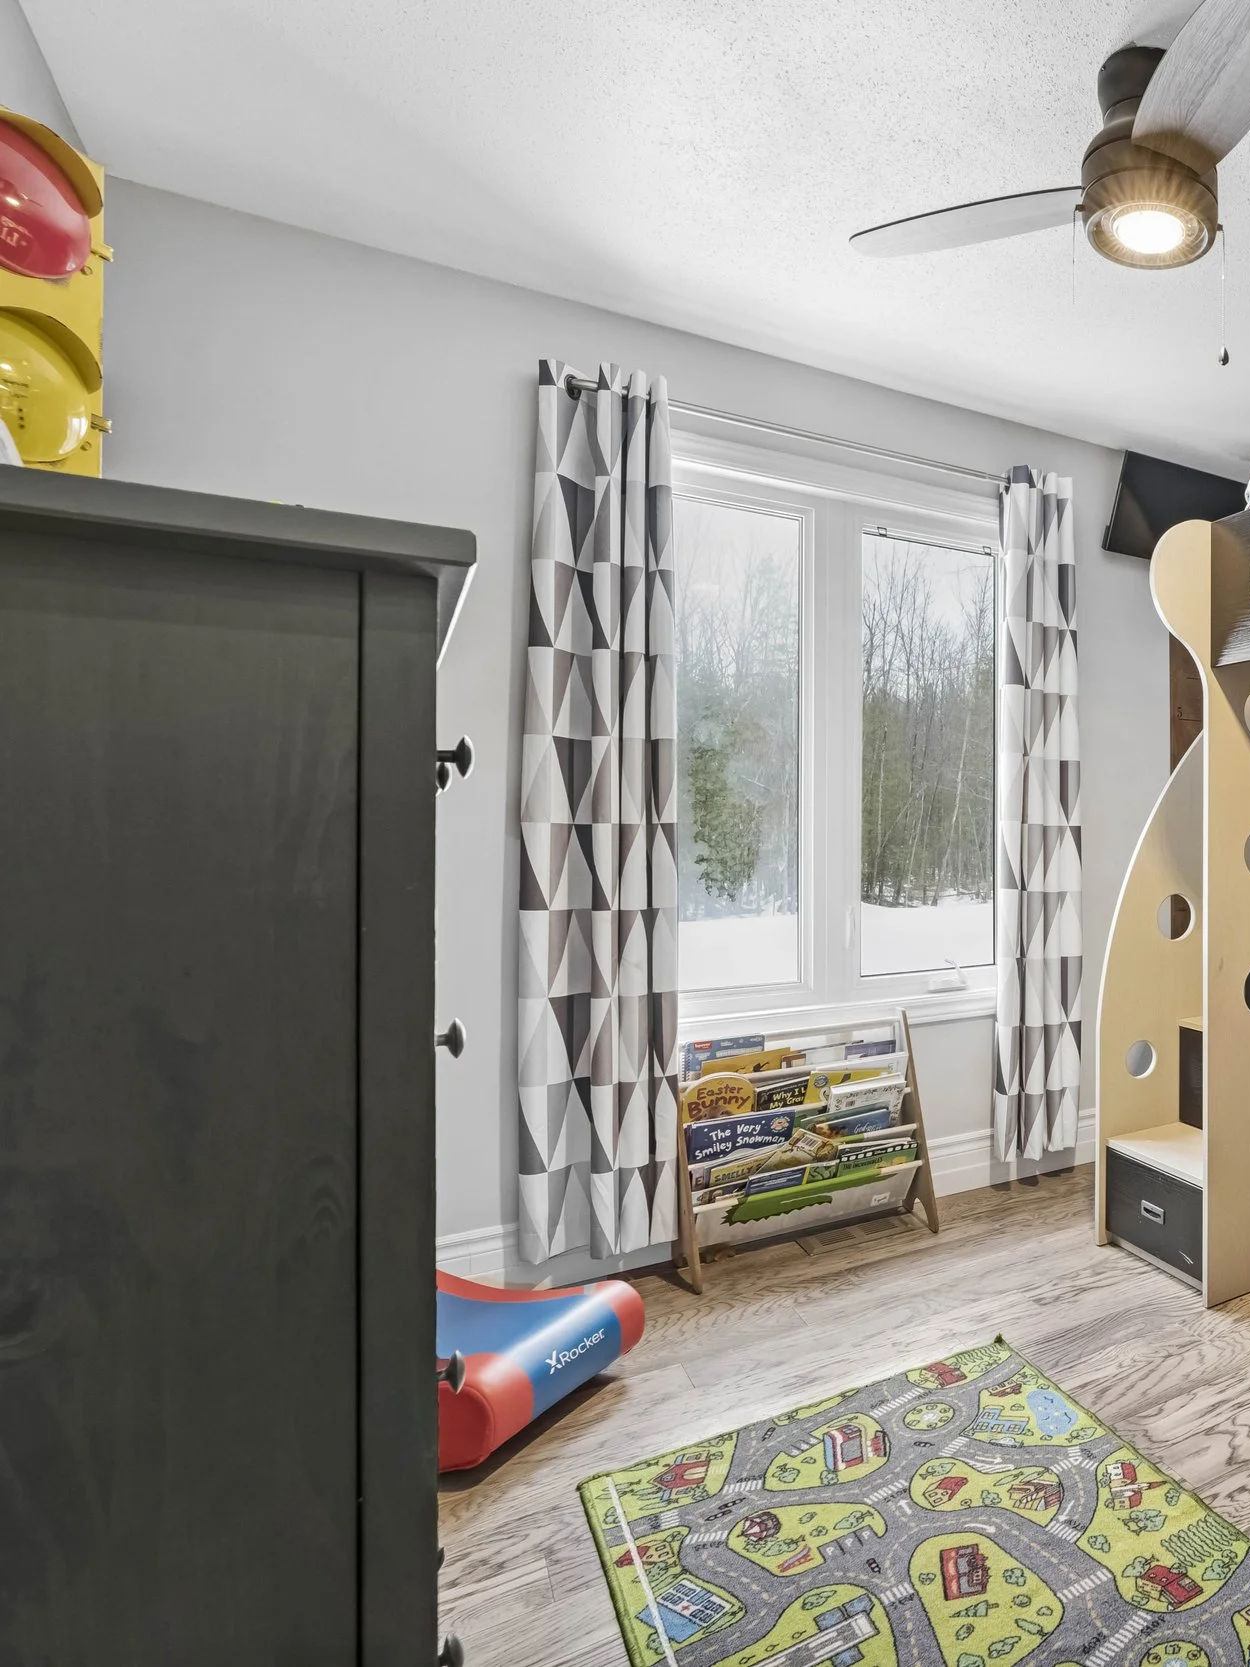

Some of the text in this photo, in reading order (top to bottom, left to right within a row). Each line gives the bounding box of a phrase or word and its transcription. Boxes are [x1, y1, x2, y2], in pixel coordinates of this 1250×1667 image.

[1176, 706, 1183, 718] 5
[697, 1084, 744, 1101] Easter
[773, 1090, 792, 1100] Why
[687, 1095, 751, 1119] Bunny
[709, 1128, 731, 1141] The
[736, 1123, 762, 1134] Very
[695, 1135, 785, 1160] Smiley Snowman
